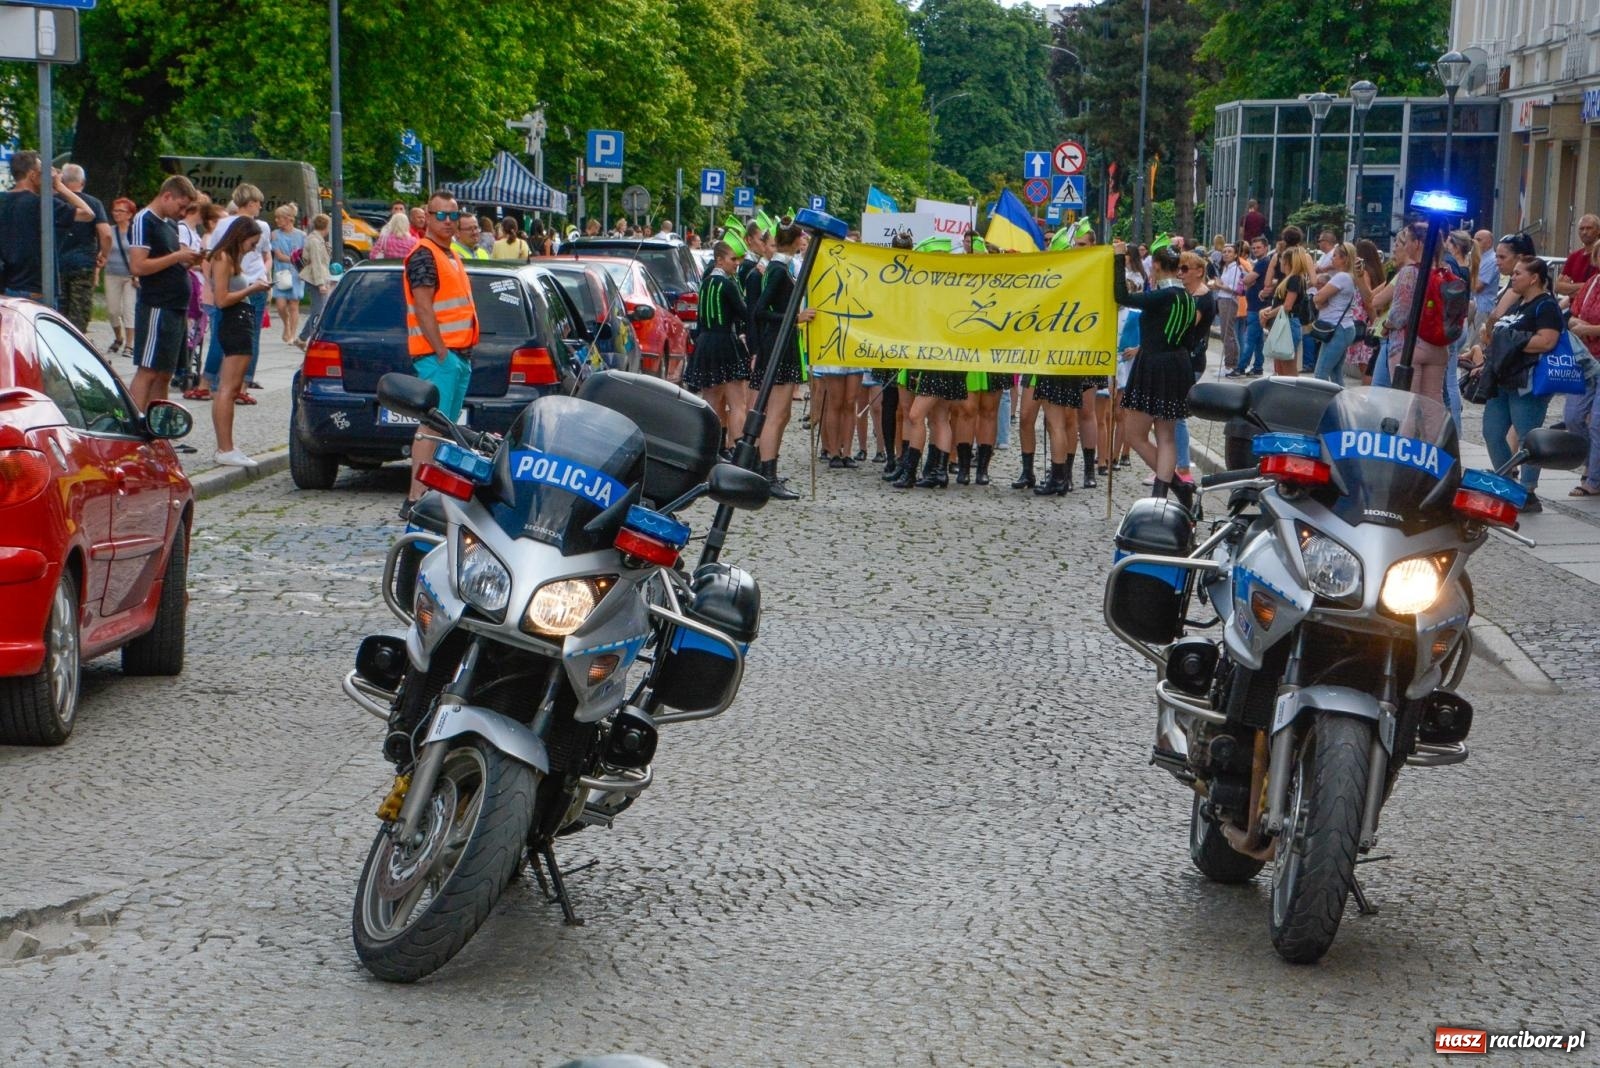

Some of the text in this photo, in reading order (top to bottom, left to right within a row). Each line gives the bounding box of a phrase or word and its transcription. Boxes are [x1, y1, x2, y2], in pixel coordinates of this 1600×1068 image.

[595, 134, 616, 163] P
[187, 163, 242, 188] Świat
[706, 172, 720, 191] P
[738, 189, 750, 205] P
[812, 198, 822, 210] P
[879, 254, 1062, 295] Stowarzyszenie
[947, 292, 1100, 334] Źródło
[855, 338, 1112, 367] ŚLĄSK KRAINA WIELU KULTUR
[1340, 431, 1439, 475] POLICJA
[516, 455, 613, 508] POLICJA
[1363, 509, 1404, 522] HONDA
[523, 523, 563, 541] HONDA
